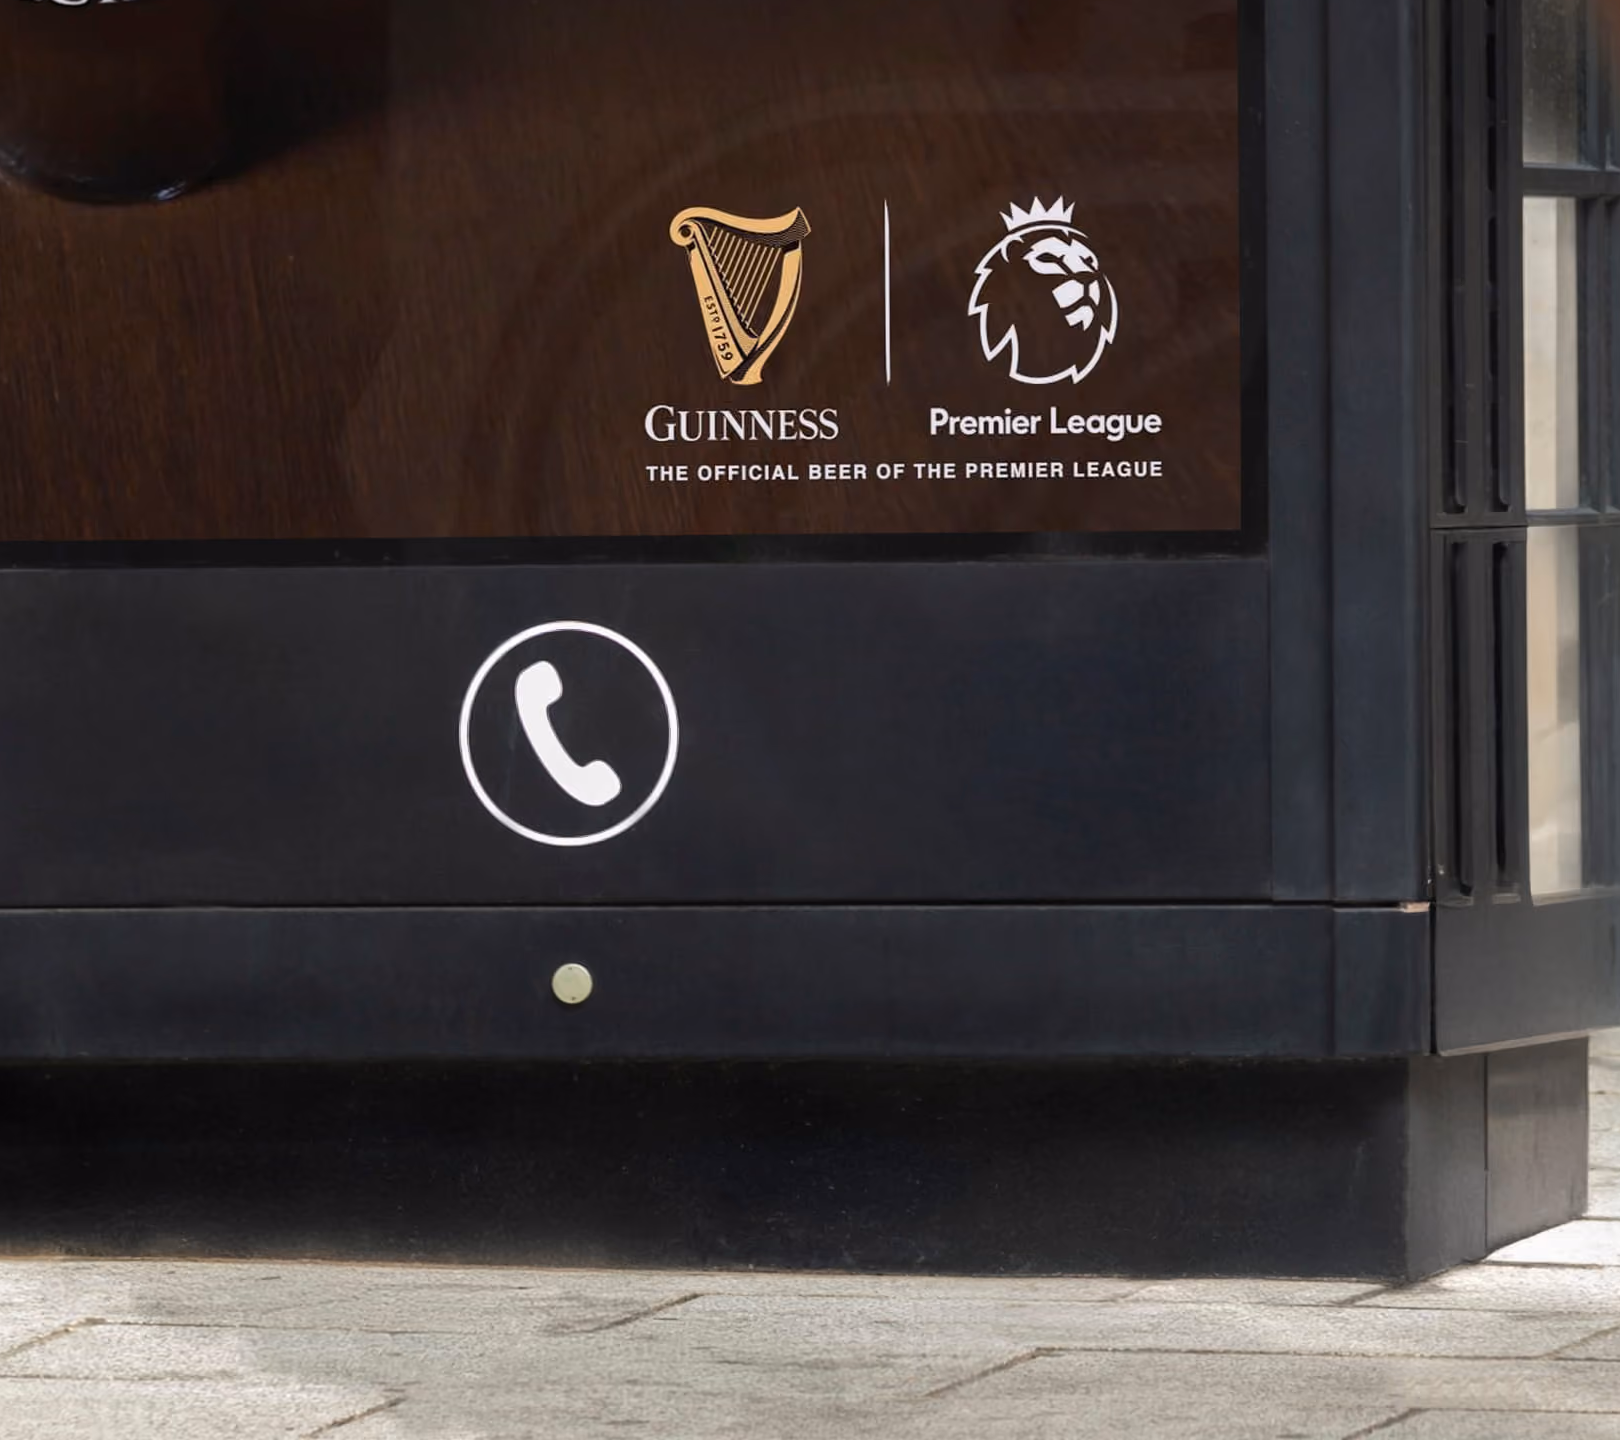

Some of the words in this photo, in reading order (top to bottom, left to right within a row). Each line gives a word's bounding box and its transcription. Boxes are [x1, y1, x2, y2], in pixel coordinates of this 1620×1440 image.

[712, 326, 733, 360] 1759
[644, 404, 839, 442] GUINNESS
[930, 407, 1042, 436] Premier
[1050, 406, 1163, 442] League
[645, 465, 689, 482] THE
[697, 464, 800, 482] OFFICIAL
[808, 463, 867, 480] BEER
[876, 463, 905, 480] OF
[912, 462, 957, 479] THE
[965, 462, 1064, 479] PREMIER
[1073, 461, 1163, 478] LEAGUE
